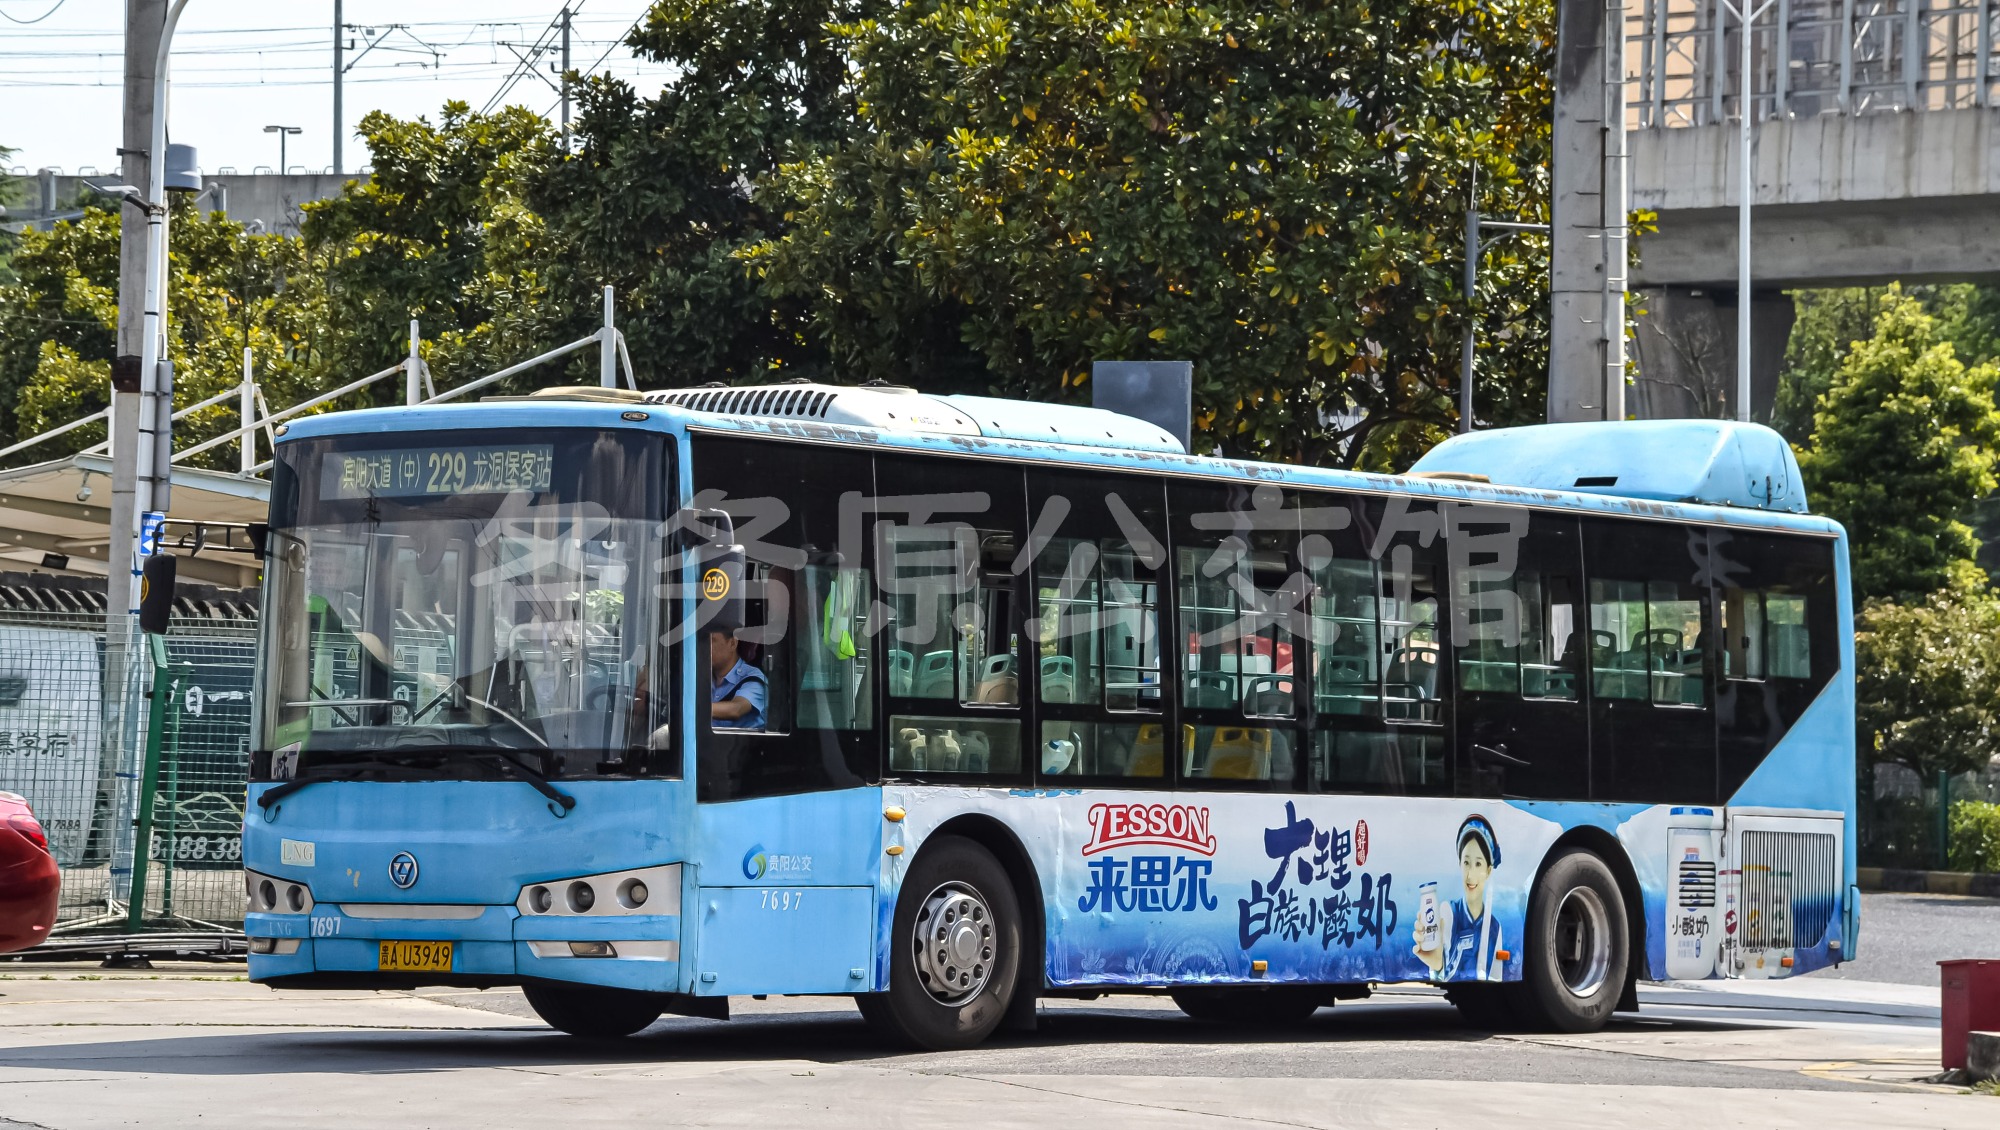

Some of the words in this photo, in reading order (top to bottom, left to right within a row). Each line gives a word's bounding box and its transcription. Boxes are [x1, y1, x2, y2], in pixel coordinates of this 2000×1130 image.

[426, 452, 467, 493] 229
[473, 450, 553, 491] 龙洞堡客站
[706, 575, 725, 593] 229
[283, 843, 314, 861] LNG
[1264, 800, 1352, 896] 大理
[768, 854, 812, 872] 贵阳公交
[1078, 856, 1218, 913] 来思尔
[761, 890, 802, 911] 7697
[1238, 873, 1398, 950] 白族小酸奶
[269, 921, 293, 937] LNG
[311, 916, 341, 937] 7697
[1672, 915, 1710, 939] 小酸奶
